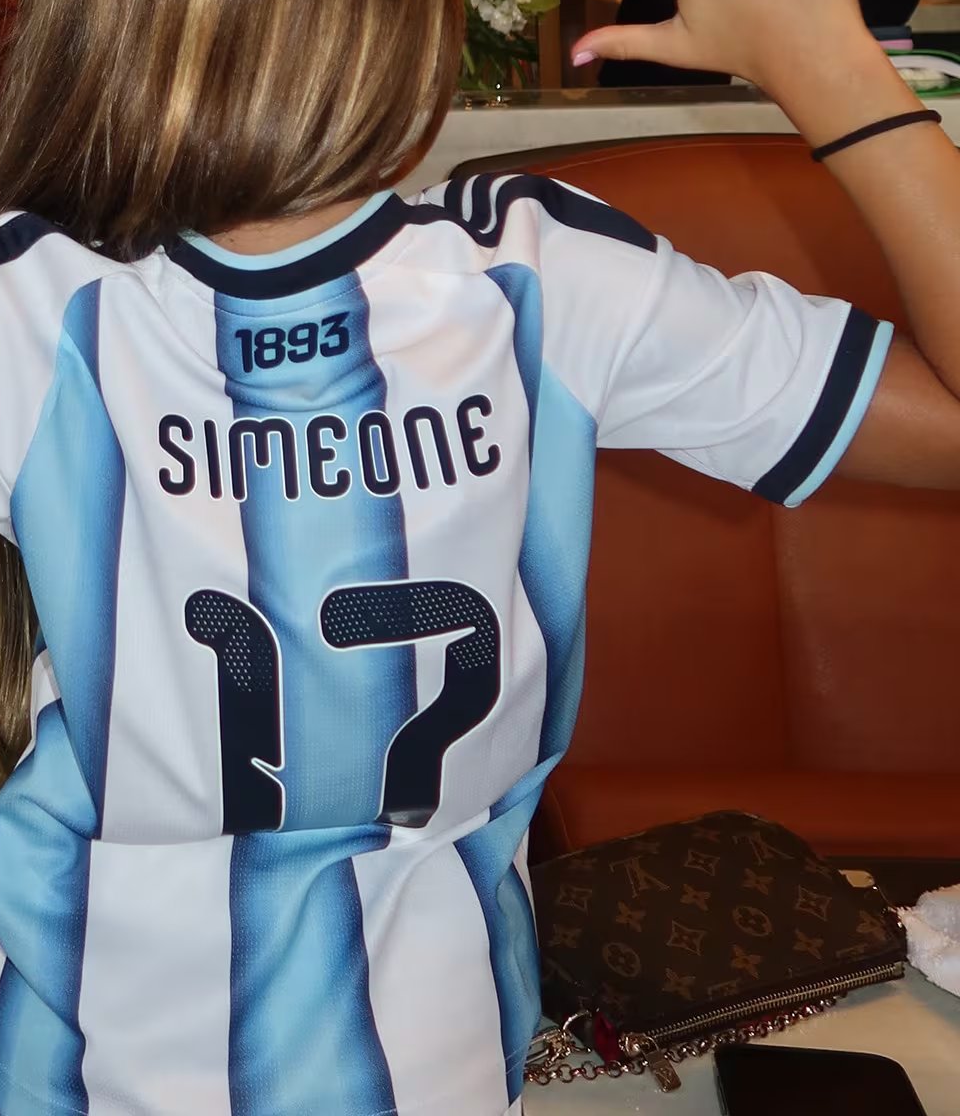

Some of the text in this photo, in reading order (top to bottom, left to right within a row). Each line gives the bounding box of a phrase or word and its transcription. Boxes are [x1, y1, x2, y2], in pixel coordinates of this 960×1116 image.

[235, 312, 350, 373] 1893
[157, 392, 503, 502] SIMEONE
[184, 579, 503, 835] 17
